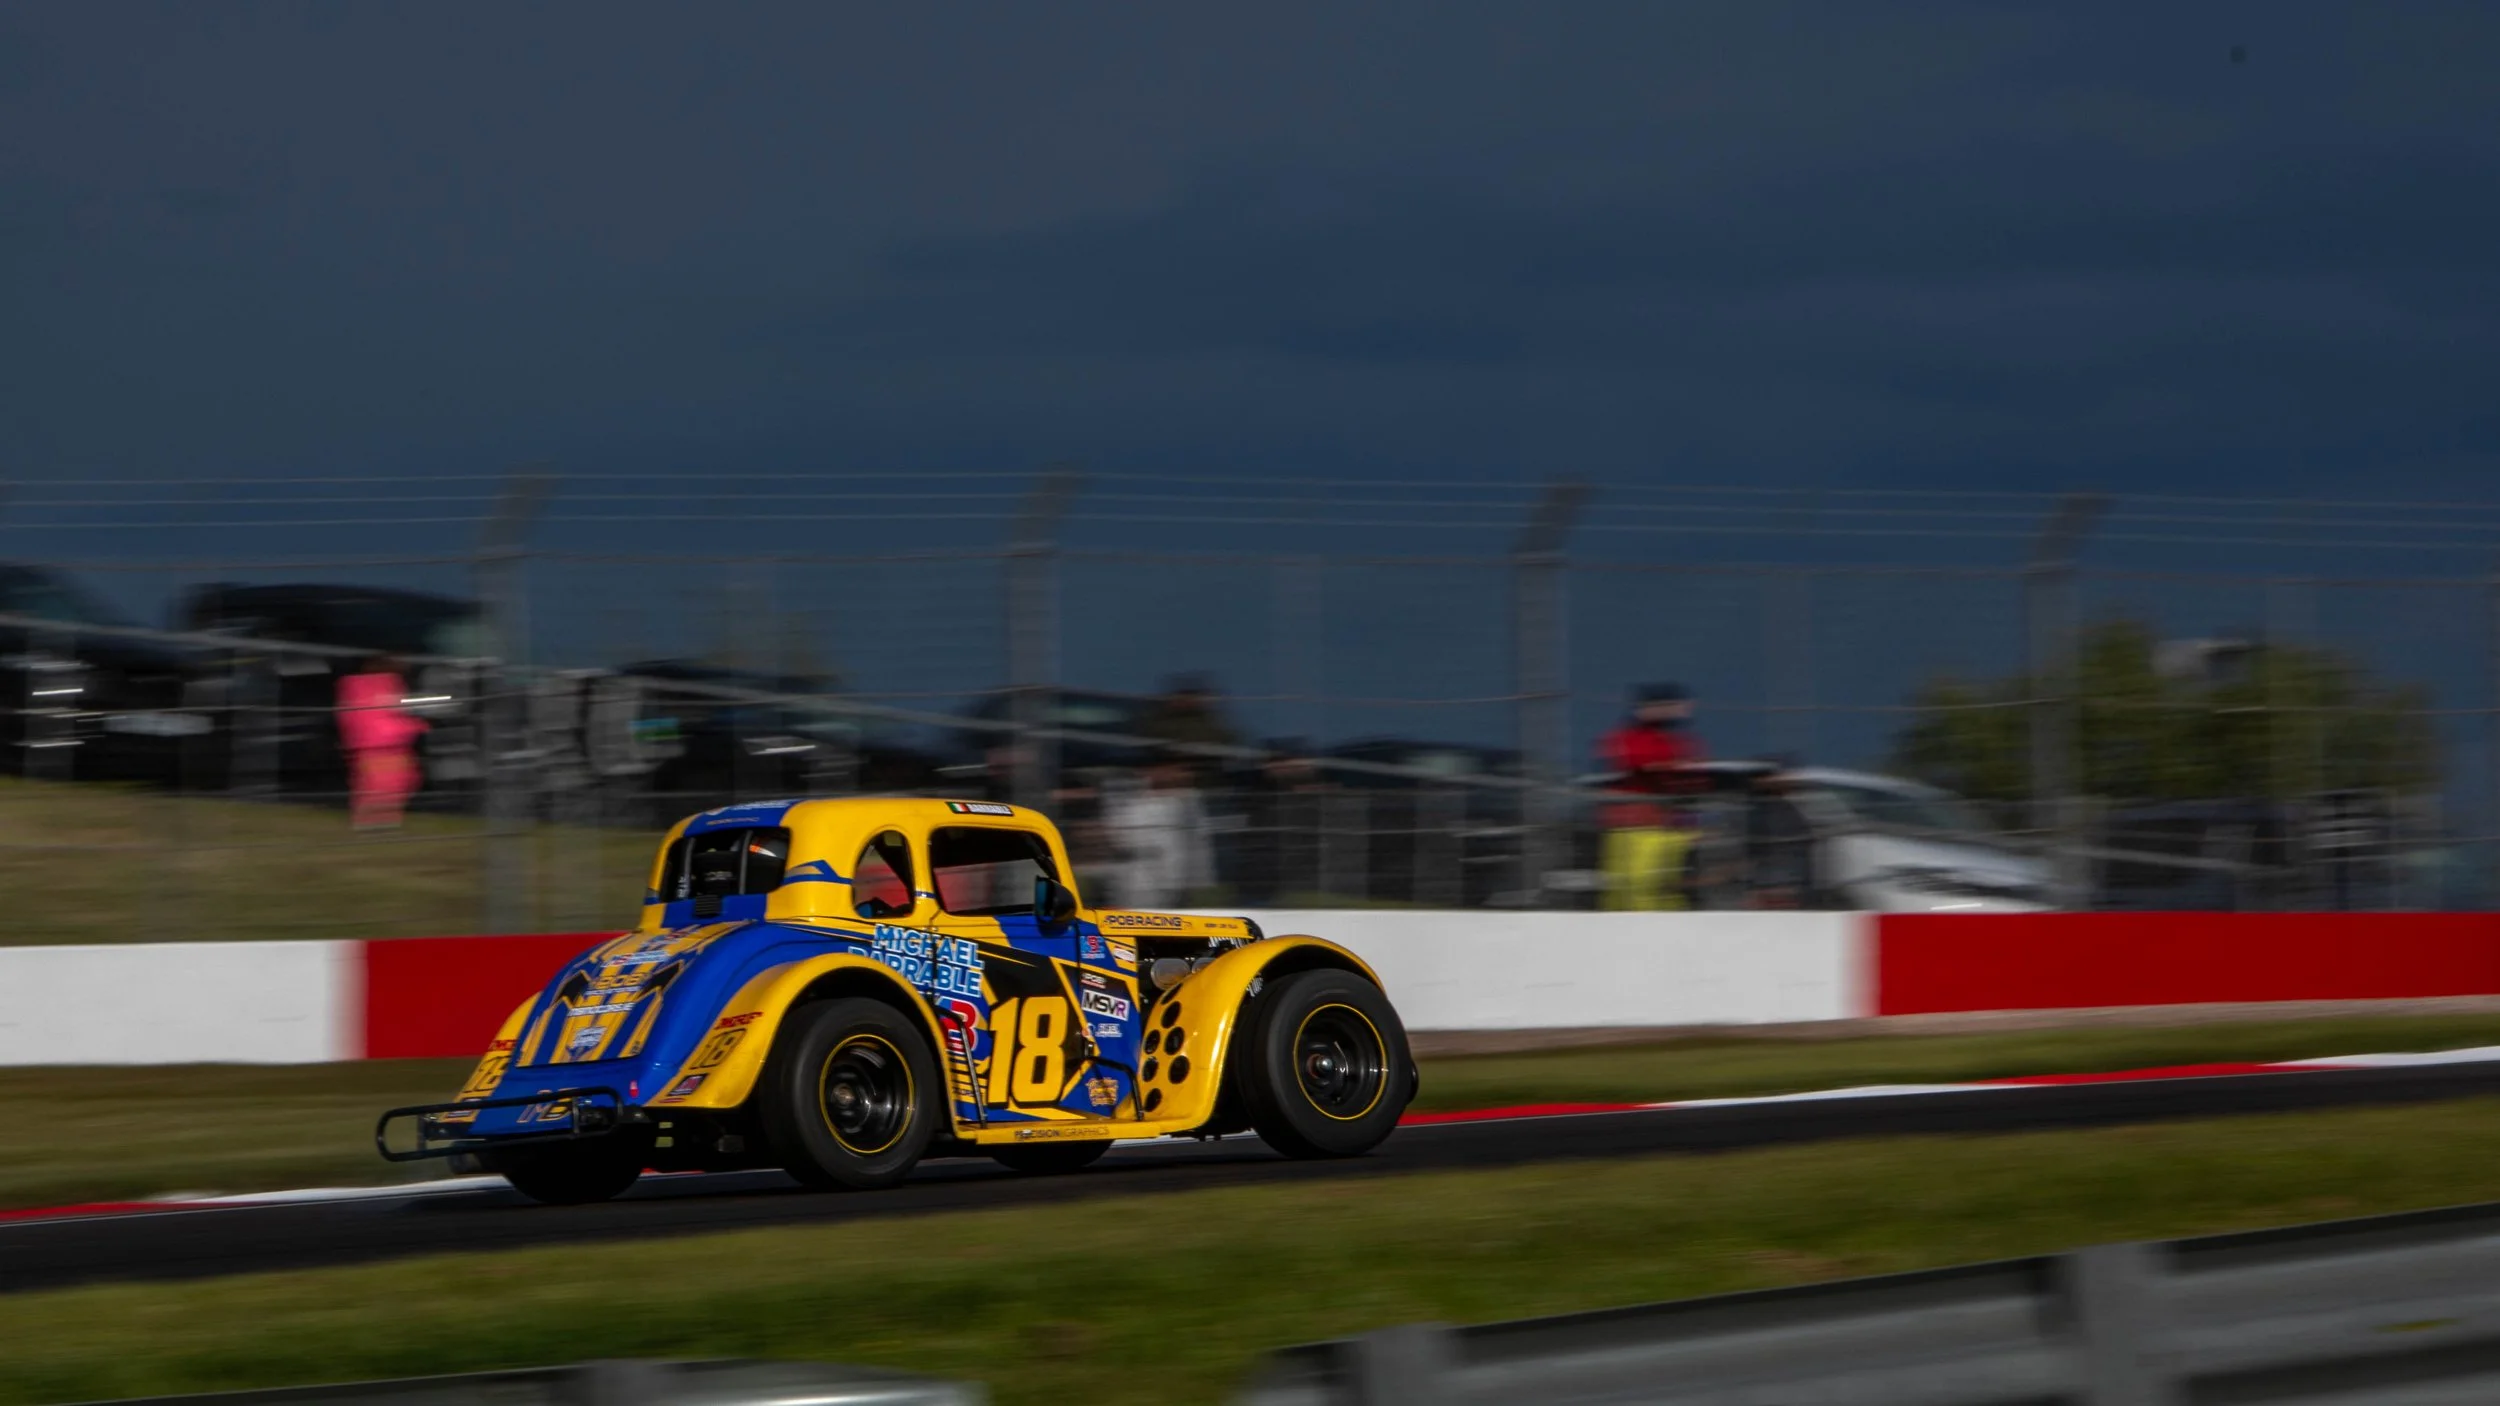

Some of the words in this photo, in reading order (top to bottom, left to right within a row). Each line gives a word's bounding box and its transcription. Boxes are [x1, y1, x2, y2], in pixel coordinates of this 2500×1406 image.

[872, 923, 985, 970] MICHAEL
[1083, 991, 1127, 1019] MSVR
[689, 1027, 747, 1070] 18
[987, 996, 1069, 1105] 18
